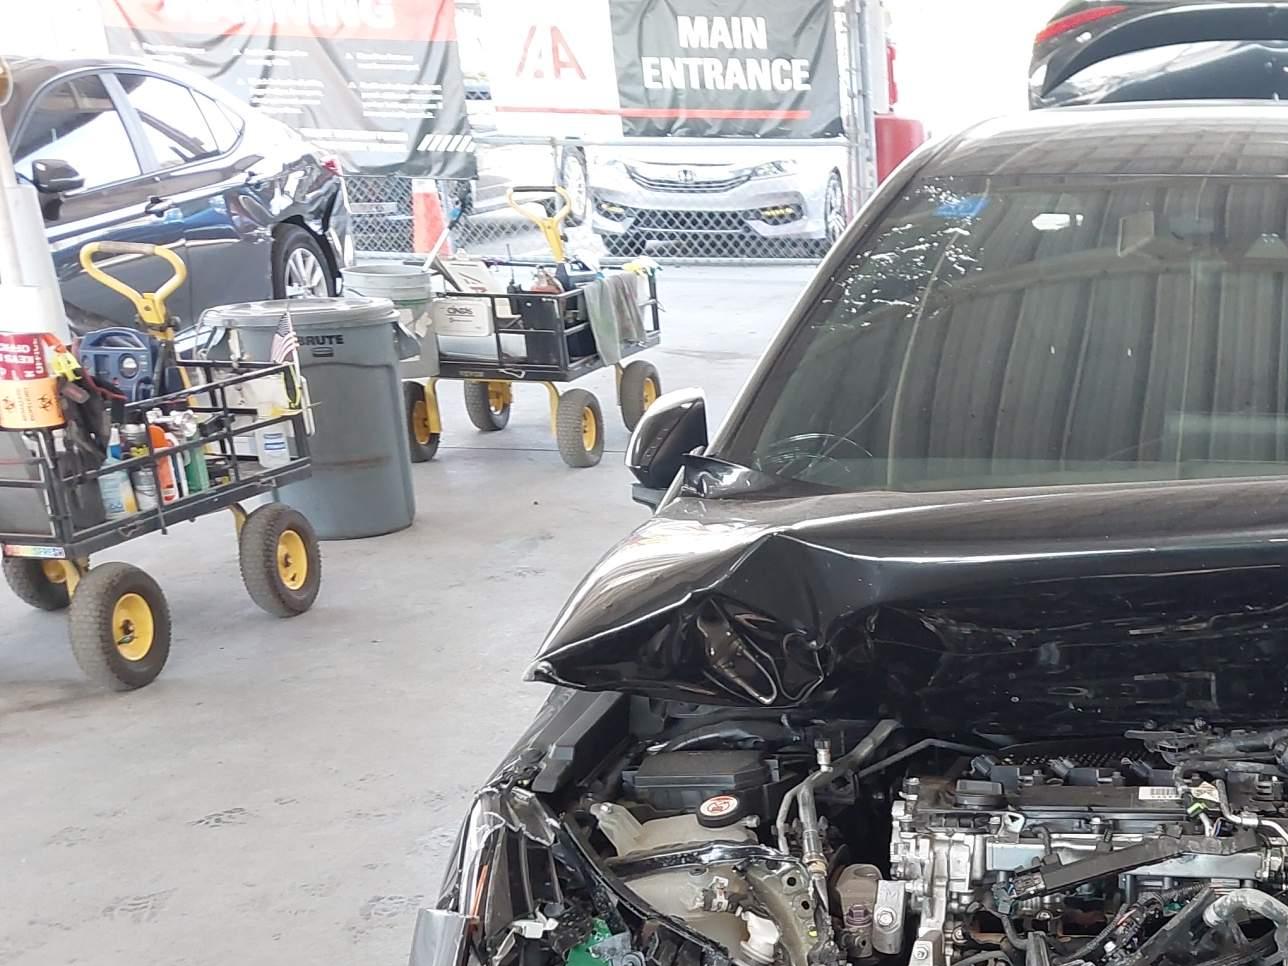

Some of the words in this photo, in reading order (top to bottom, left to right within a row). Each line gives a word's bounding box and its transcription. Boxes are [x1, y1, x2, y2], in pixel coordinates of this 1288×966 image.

[677, 15, 768, 50] MAIN
[641, 56, 812, 91] ENTRANCE
[296, 335, 345, 346] BRUTE
